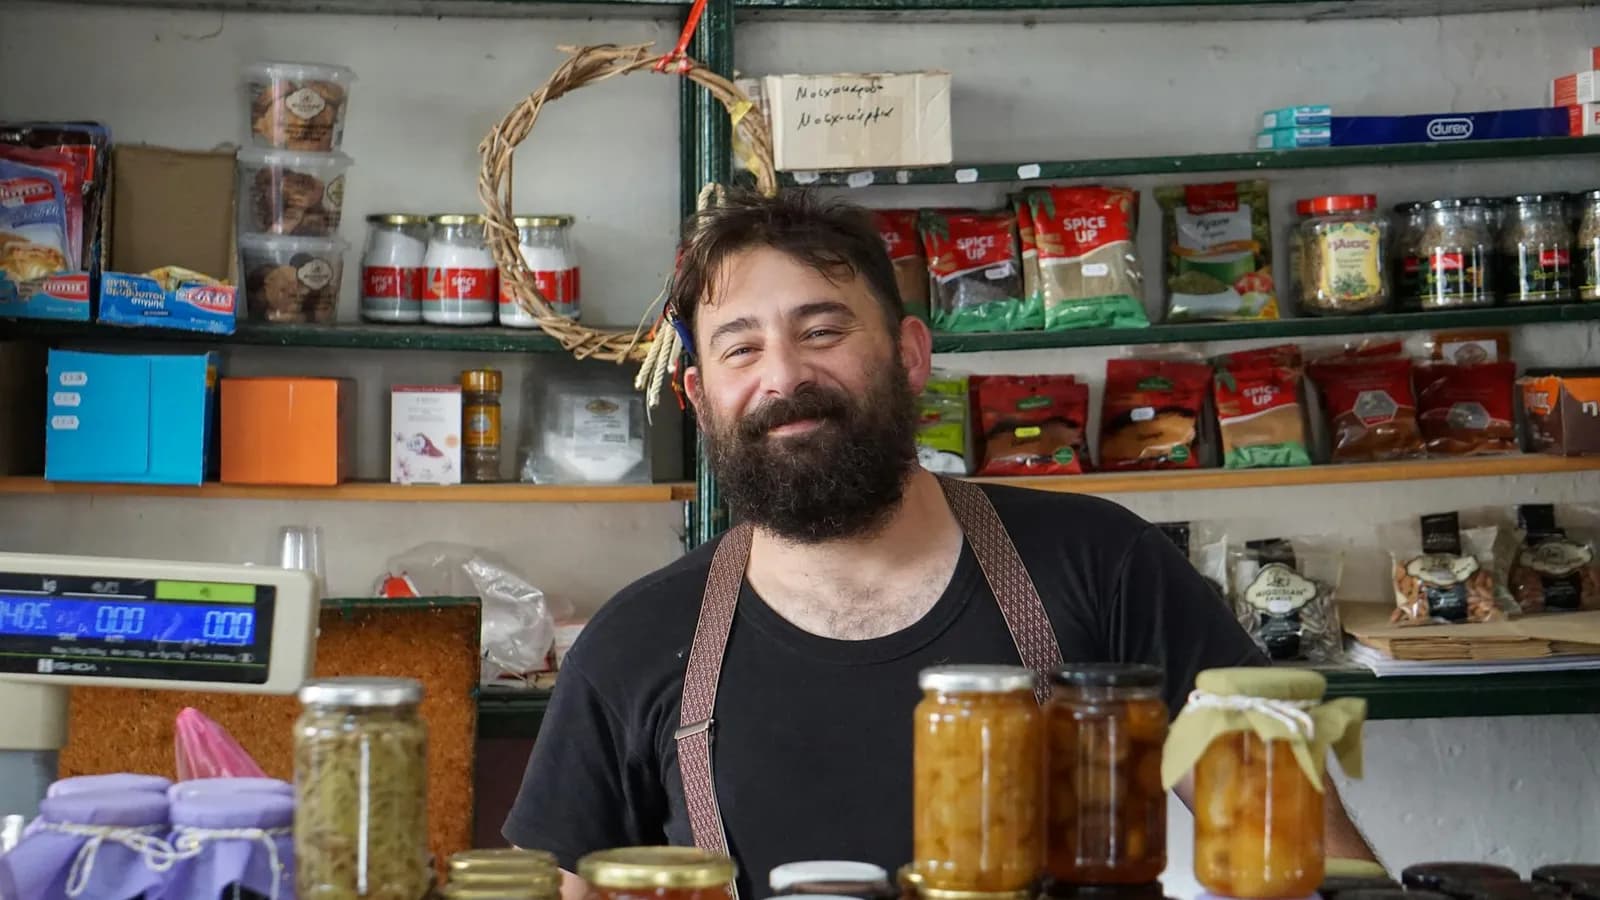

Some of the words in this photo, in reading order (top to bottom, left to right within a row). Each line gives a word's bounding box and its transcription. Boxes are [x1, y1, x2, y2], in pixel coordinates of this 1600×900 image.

[1431, 121, 1470, 136] durex
[1063, 216, 1107, 231] SPICE
[956, 235, 994, 250] SPICE
[1074, 229, 1099, 243] UP
[966, 248, 987, 260] UP
[451, 275, 476, 287] SPICE
[1252, 394, 1273, 406] UP
